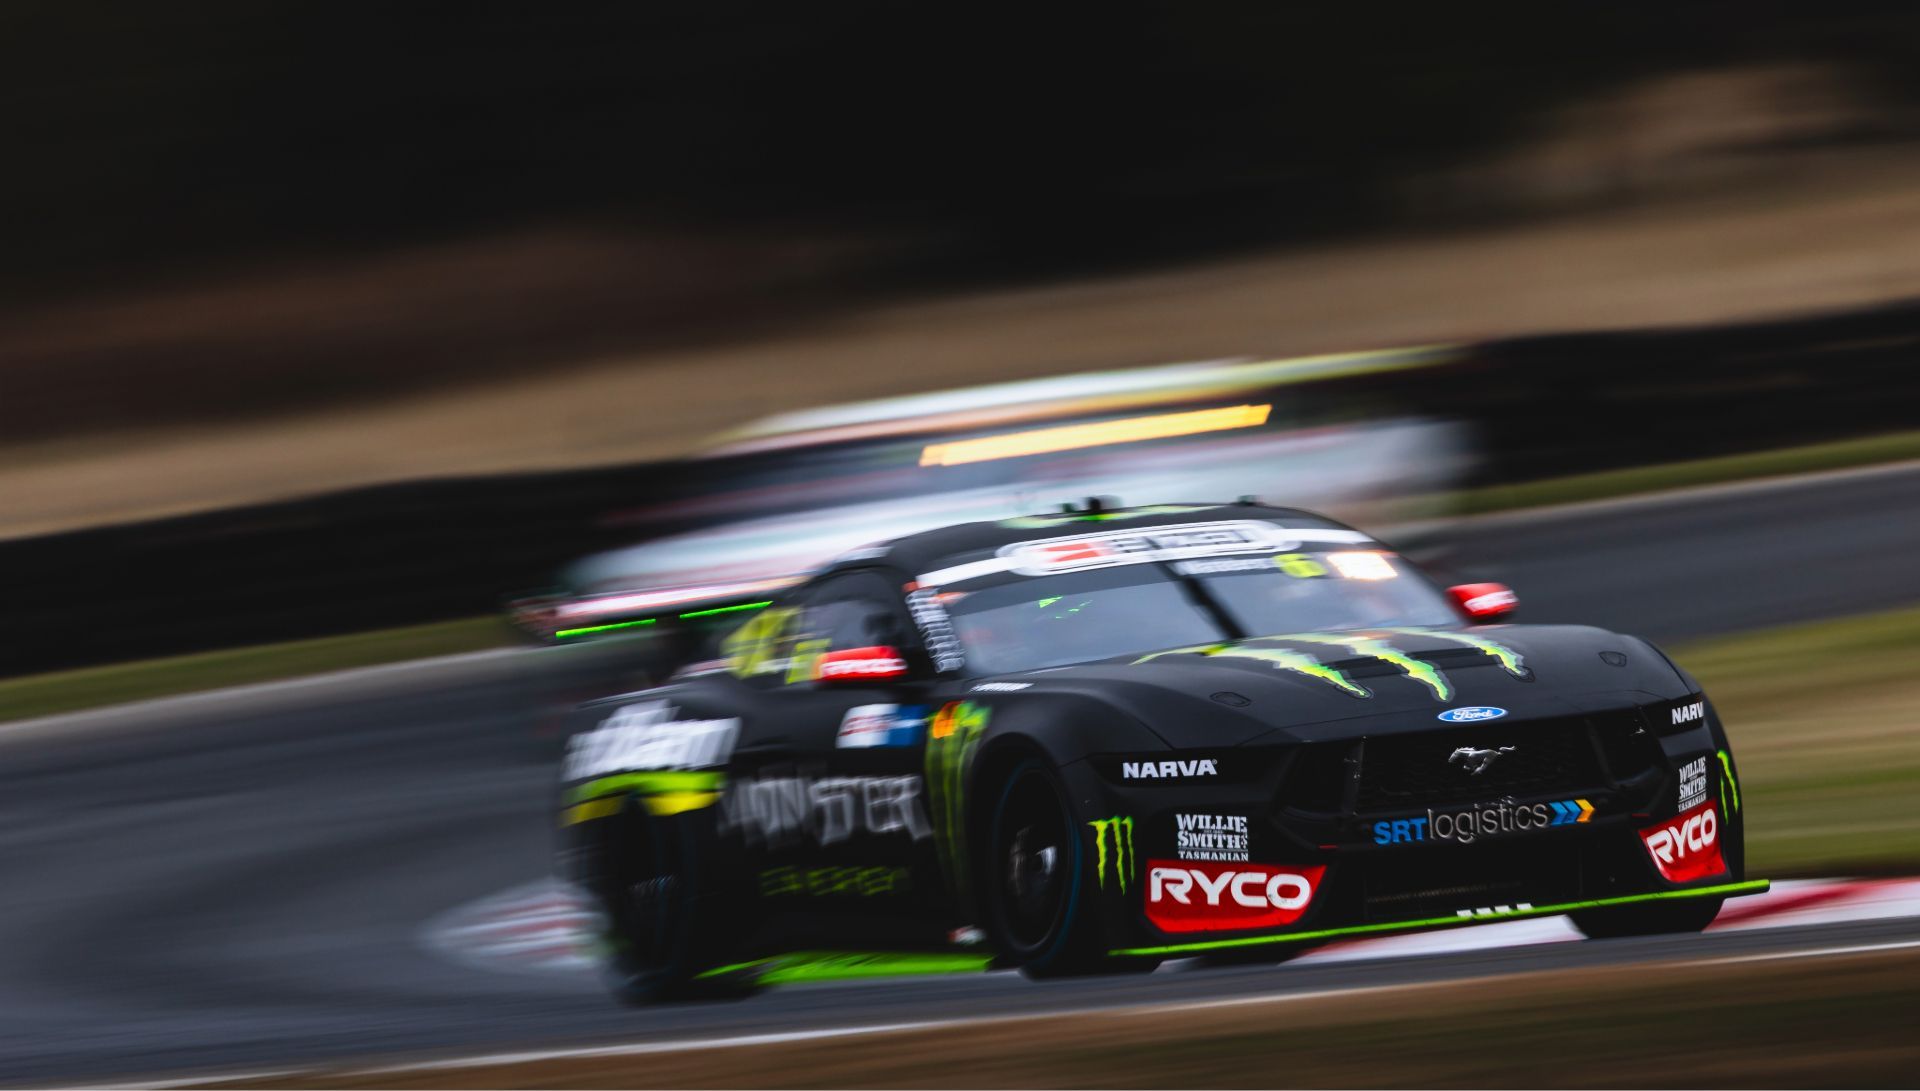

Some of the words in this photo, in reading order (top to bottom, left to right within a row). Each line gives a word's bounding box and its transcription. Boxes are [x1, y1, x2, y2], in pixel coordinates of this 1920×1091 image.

[1453, 709, 1493, 720] Ford
[1123, 759, 1218, 778] NARVA
[1176, 813, 1248, 833] WILLIE
[1646, 808, 1716, 870] RYCO
[1178, 850, 1249, 862] TASMANIAN
[1150, 867, 1312, 910] RYCO
